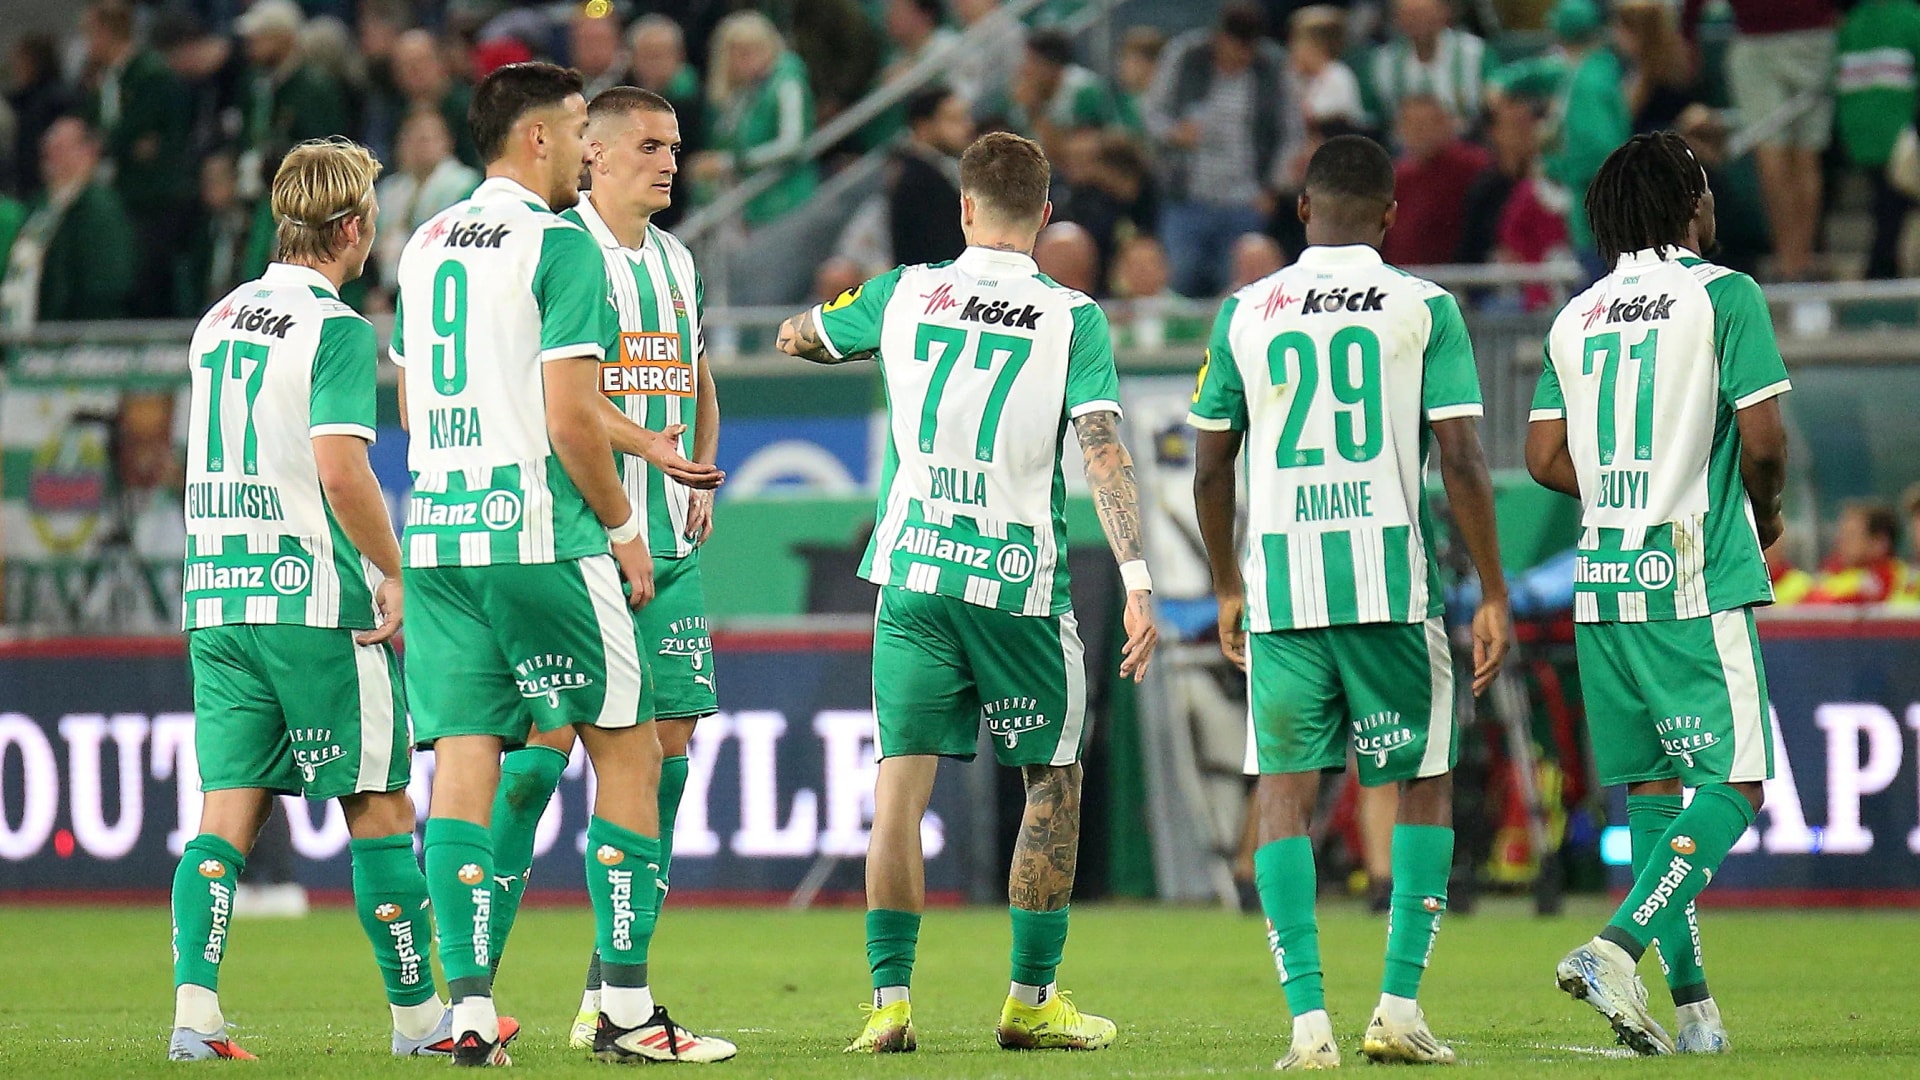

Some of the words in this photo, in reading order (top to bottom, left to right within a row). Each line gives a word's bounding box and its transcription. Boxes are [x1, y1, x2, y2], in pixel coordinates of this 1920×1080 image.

[444, 220, 512, 249] köck
[960, 296, 1043, 330] köck
[1301, 287, 1389, 316] köck
[1606, 294, 1677, 324] köck
[231, 304, 296, 339] köck
[432, 259, 467, 396] 9
[624, 337, 679, 361] WIEN
[603, 366, 692, 392] ENERGIE
[914, 322, 1033, 463] 77
[1267, 325, 1384, 469] 29
[1583, 328, 1658, 467] 71
[200, 339, 270, 476] 17
[429, 407, 482, 449] KARA
[188, 481, 284, 521] GULLIKSEN
[929, 465, 987, 507] BOLLA
[1295, 481, 1373, 523] AMANE
[1597, 470, 1648, 509] BUYI
[406, 496, 478, 527] llianz
[895, 526, 992, 570] Allianz
[185, 561, 265, 593] Allianz
[515, 653, 574, 677] WIENER
[983, 697, 1037, 715] WIENER
[985, 714, 1046, 731] UCKER
[1352, 710, 1400, 733] WIENER
[288, 728, 331, 743] IENER
[607, 868, 634, 951] easystaff
[1632, 855, 1693, 927] easystaff
[203, 881, 230, 964] easystaff
